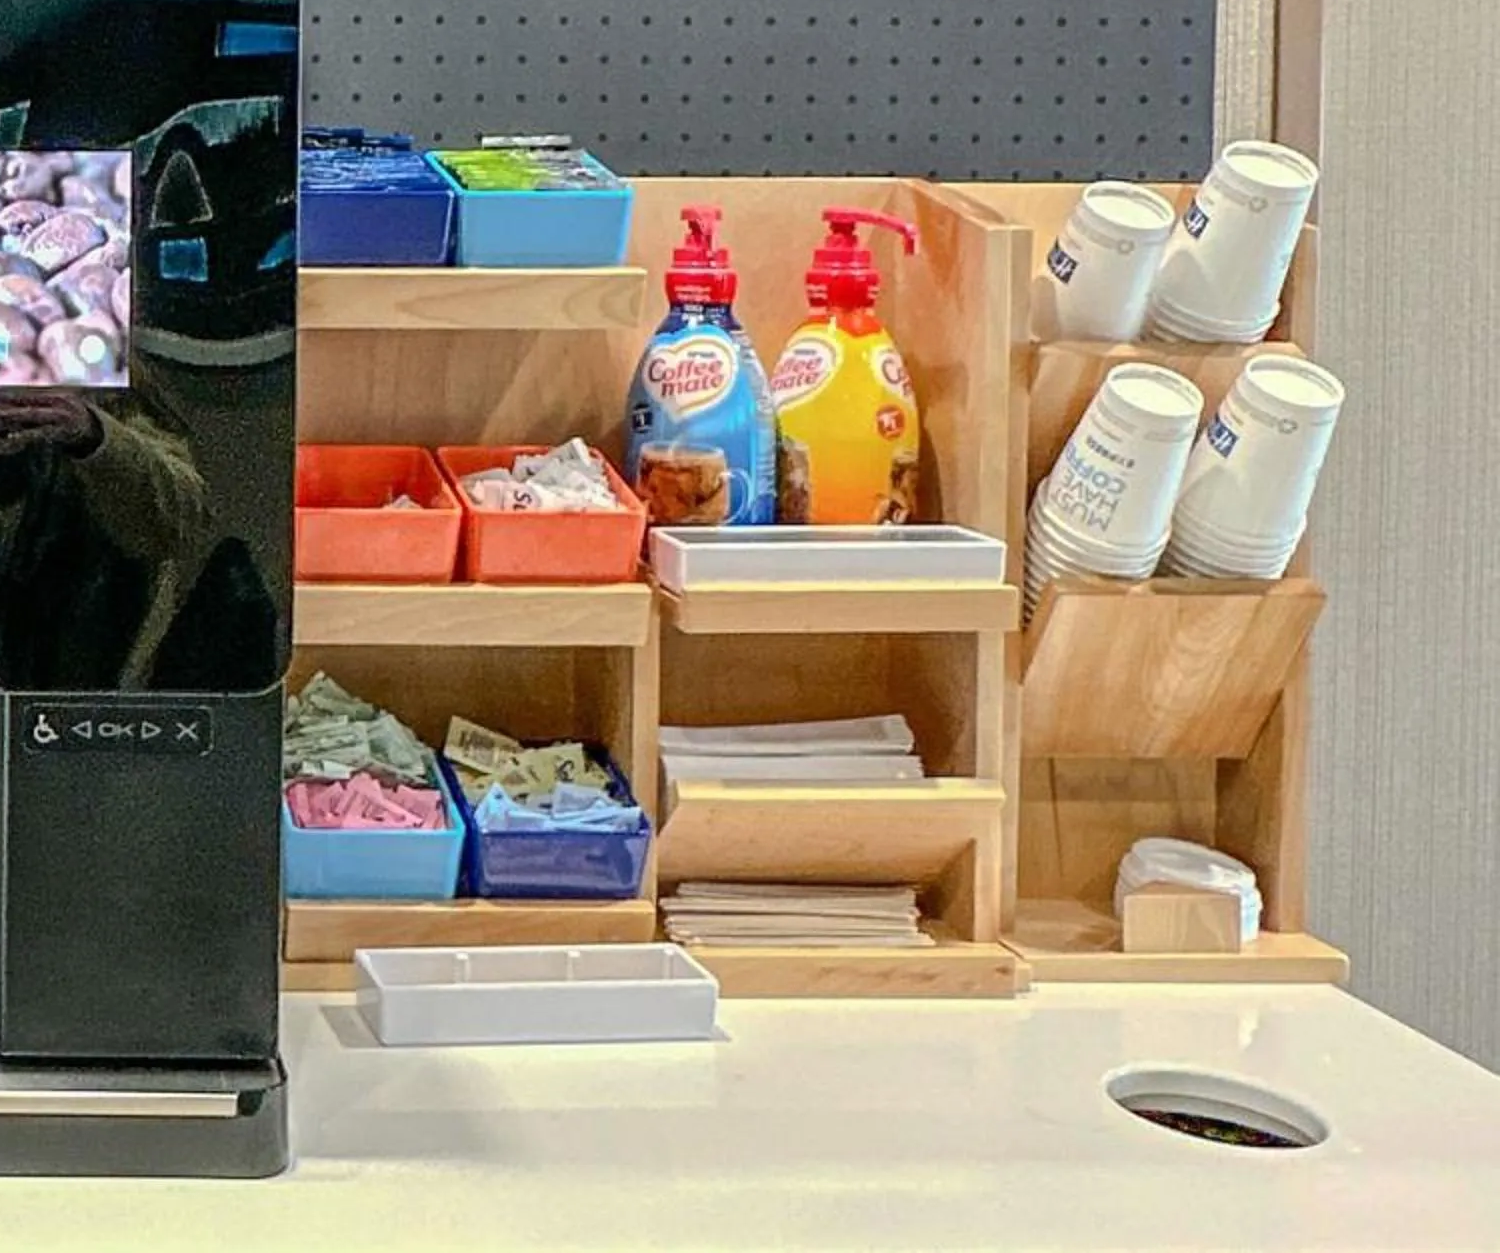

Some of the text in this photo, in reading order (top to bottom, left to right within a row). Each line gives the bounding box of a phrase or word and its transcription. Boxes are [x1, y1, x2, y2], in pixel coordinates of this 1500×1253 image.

[648, 357, 724, 382] Coffee
[661, 374, 724, 399] mate
[99, 722, 134, 737] OK
